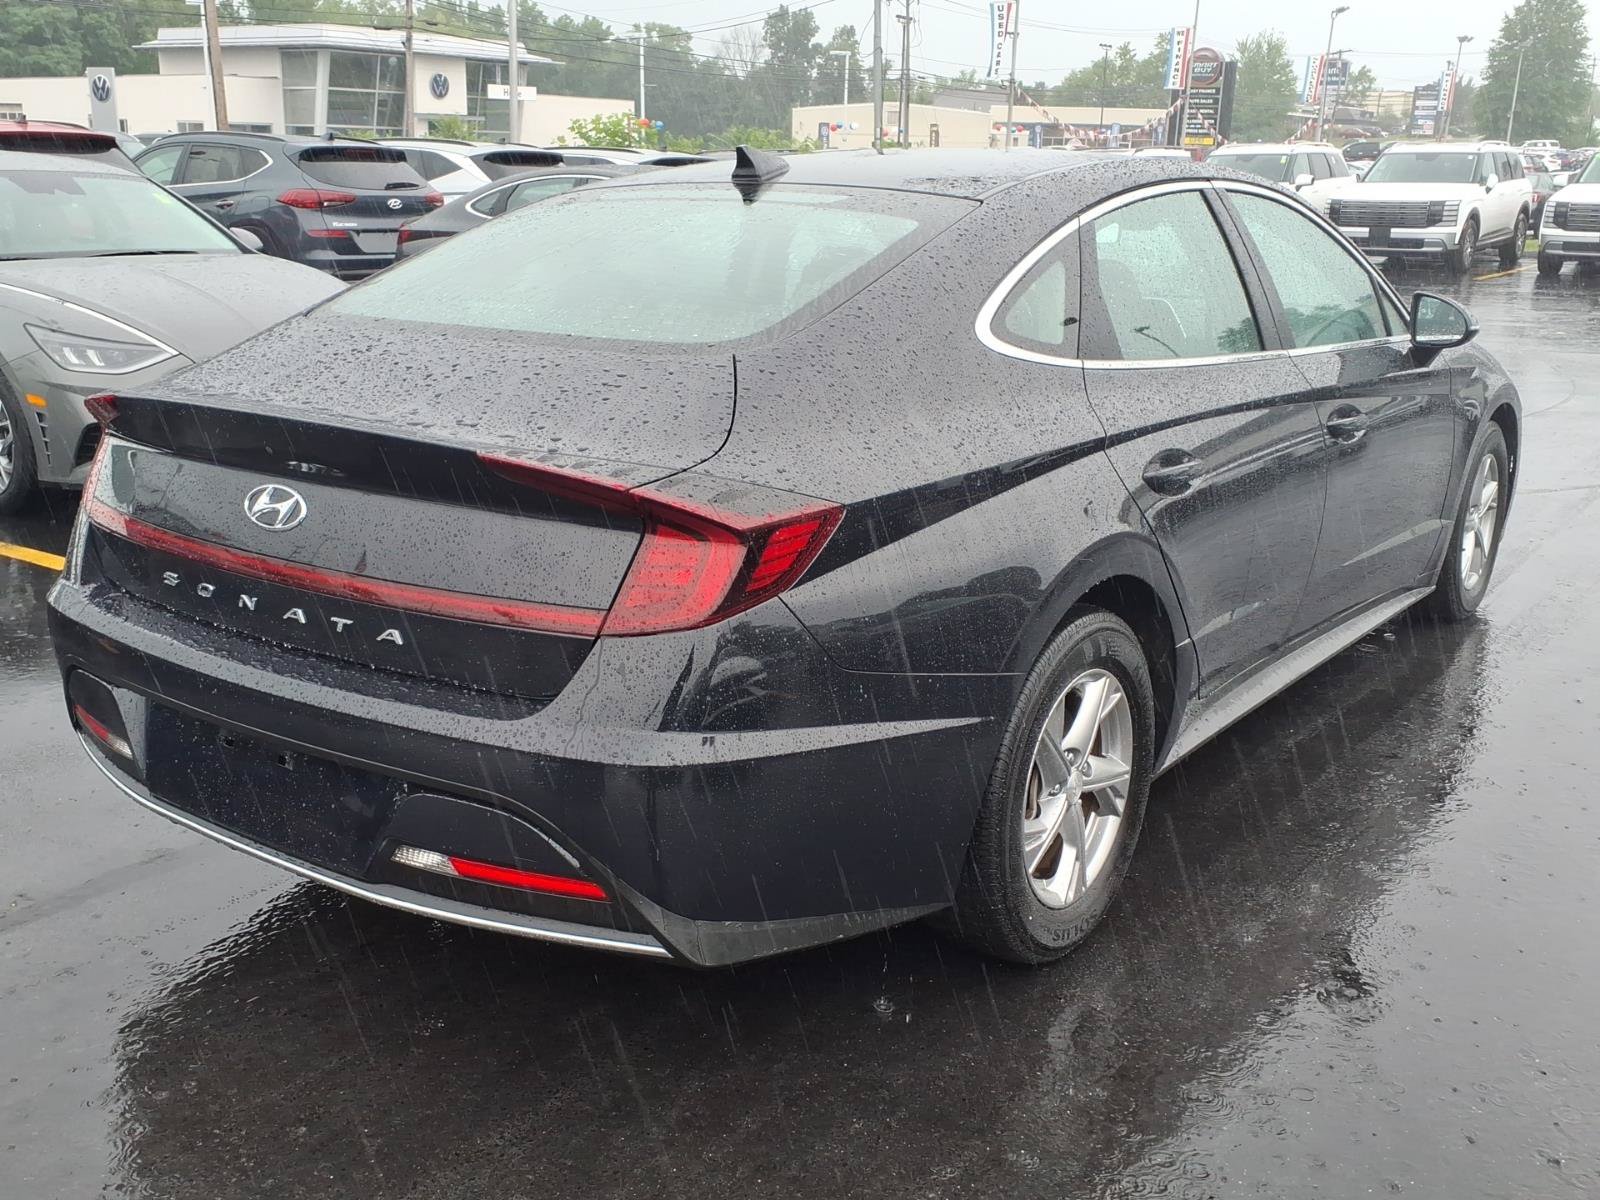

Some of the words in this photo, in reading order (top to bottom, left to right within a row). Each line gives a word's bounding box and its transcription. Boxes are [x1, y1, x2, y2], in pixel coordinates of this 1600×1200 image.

[997, 5, 1005, 38] USED
[1172, 40, 1181, 86] FINANCE
[162, 569, 405, 646] SONATA
